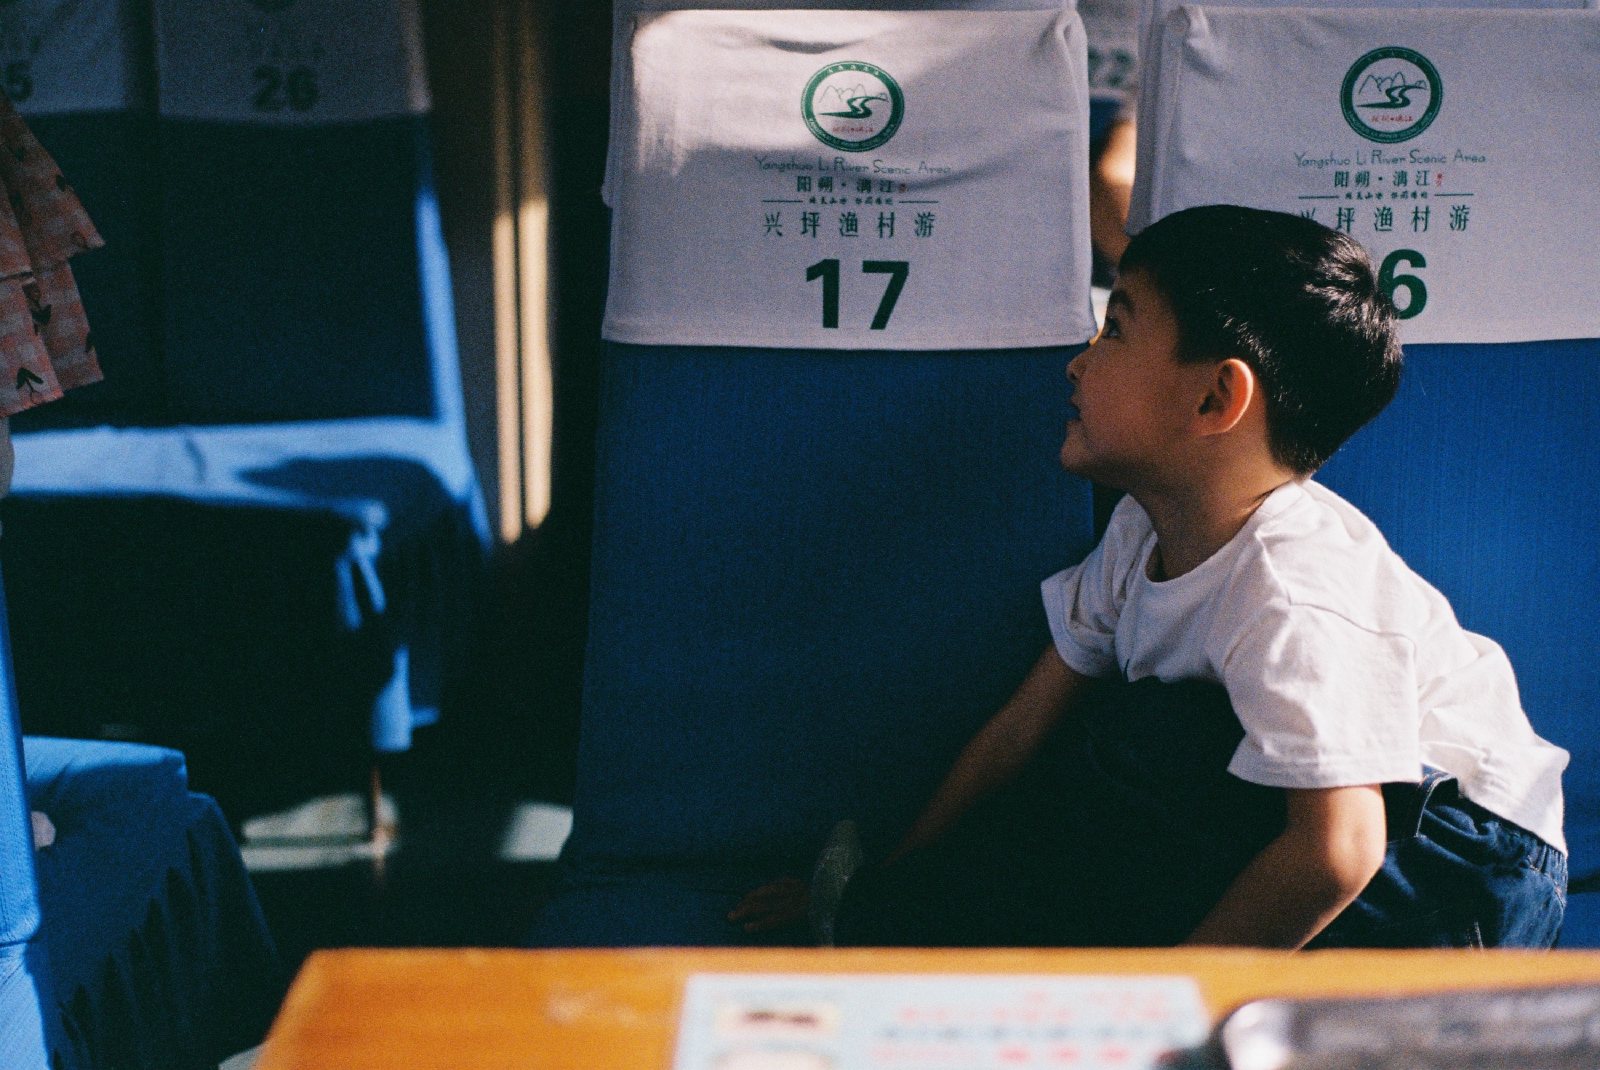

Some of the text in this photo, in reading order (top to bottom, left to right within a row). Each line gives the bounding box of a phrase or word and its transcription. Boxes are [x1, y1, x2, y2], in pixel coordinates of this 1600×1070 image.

[251, 65, 319, 112] 26
[754, 156, 951, 174] Yangshuo Li River Scenic Area
[1294, 149, 1486, 169] Yangshuo Li River Scenic Area
[763, 211, 936, 239] 兴坪渔村游
[806, 259, 910, 330] 17
